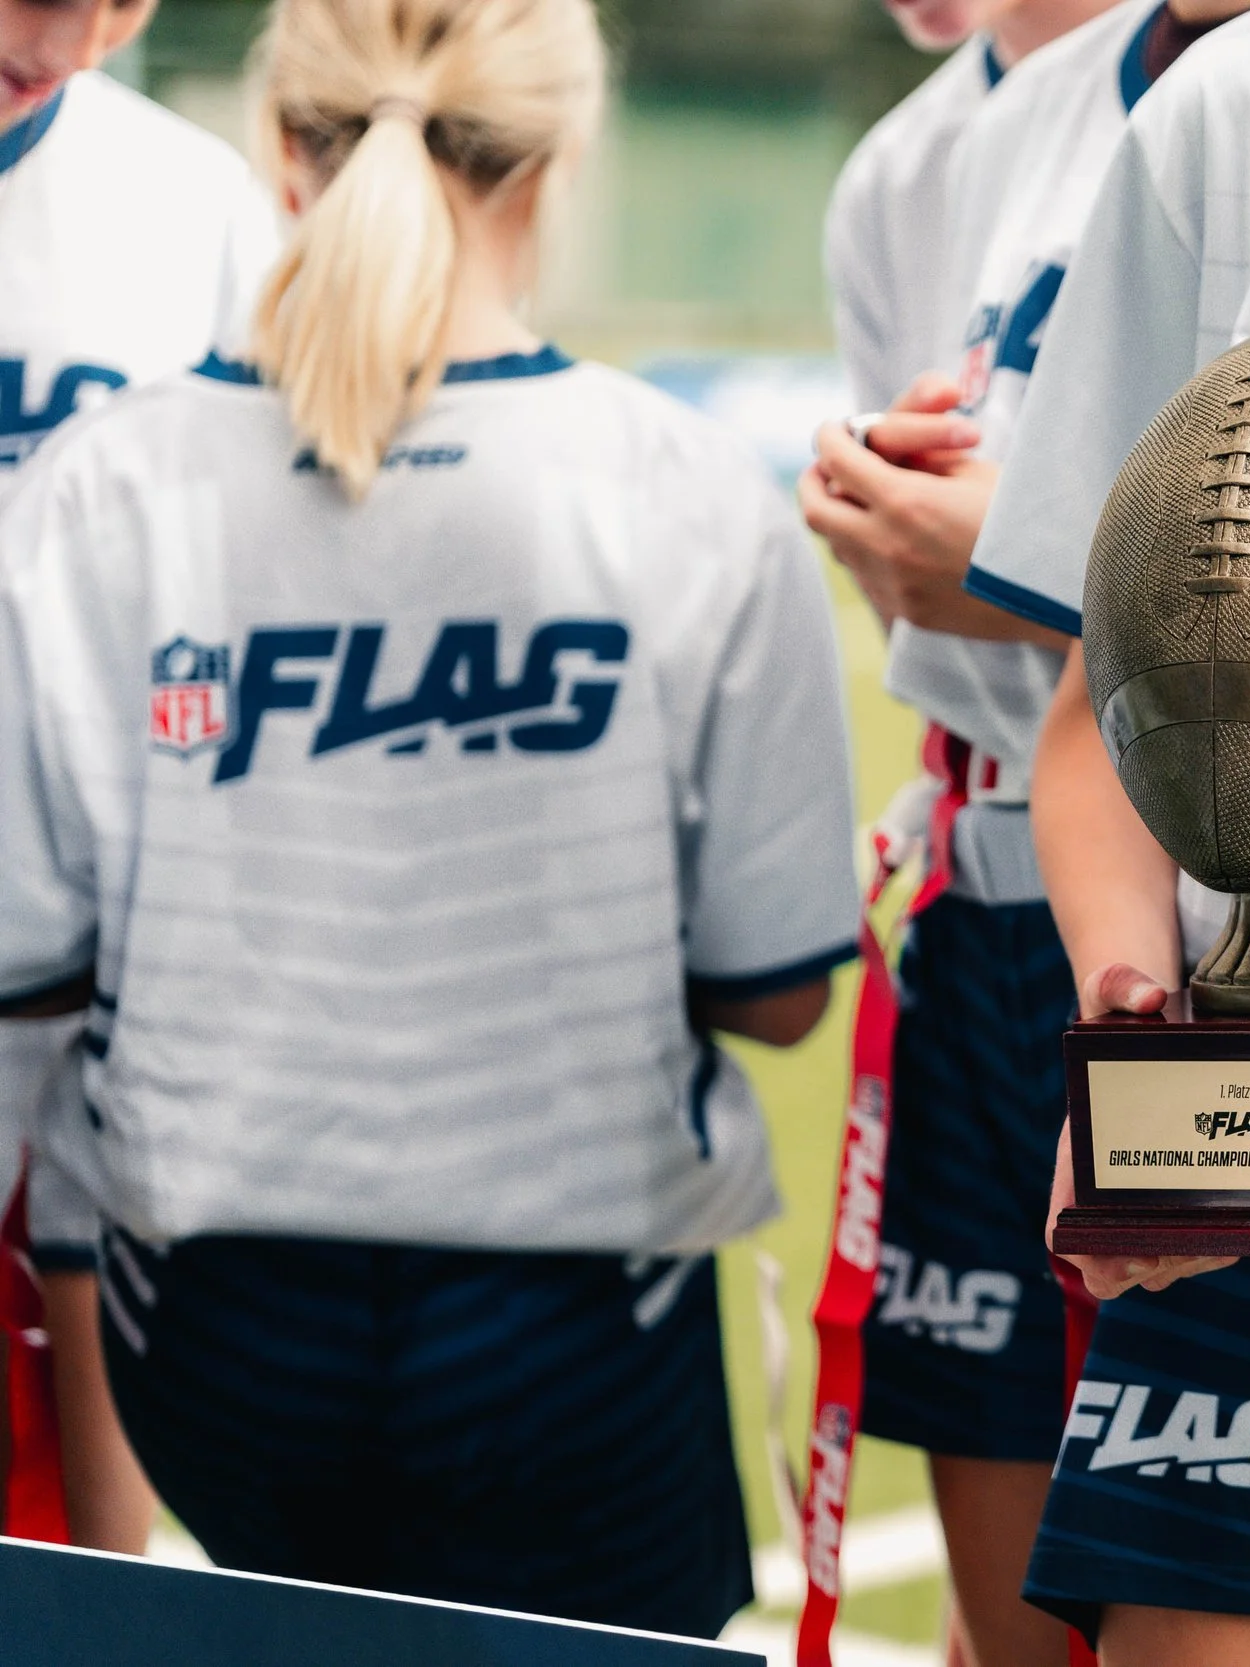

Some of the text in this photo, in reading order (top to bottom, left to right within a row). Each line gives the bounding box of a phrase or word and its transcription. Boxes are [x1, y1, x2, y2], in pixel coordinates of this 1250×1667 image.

[212, 619, 630, 785] FLAG
[1220, 1083, 1250, 1099] 1. Platz
[838, 1106, 889, 1273] FLAG
[1109, 1150, 1141, 1167] GIRLS
[1142, 1150, 1195, 1167] NATIONAL
[873, 1240, 1022, 1355] LAG
